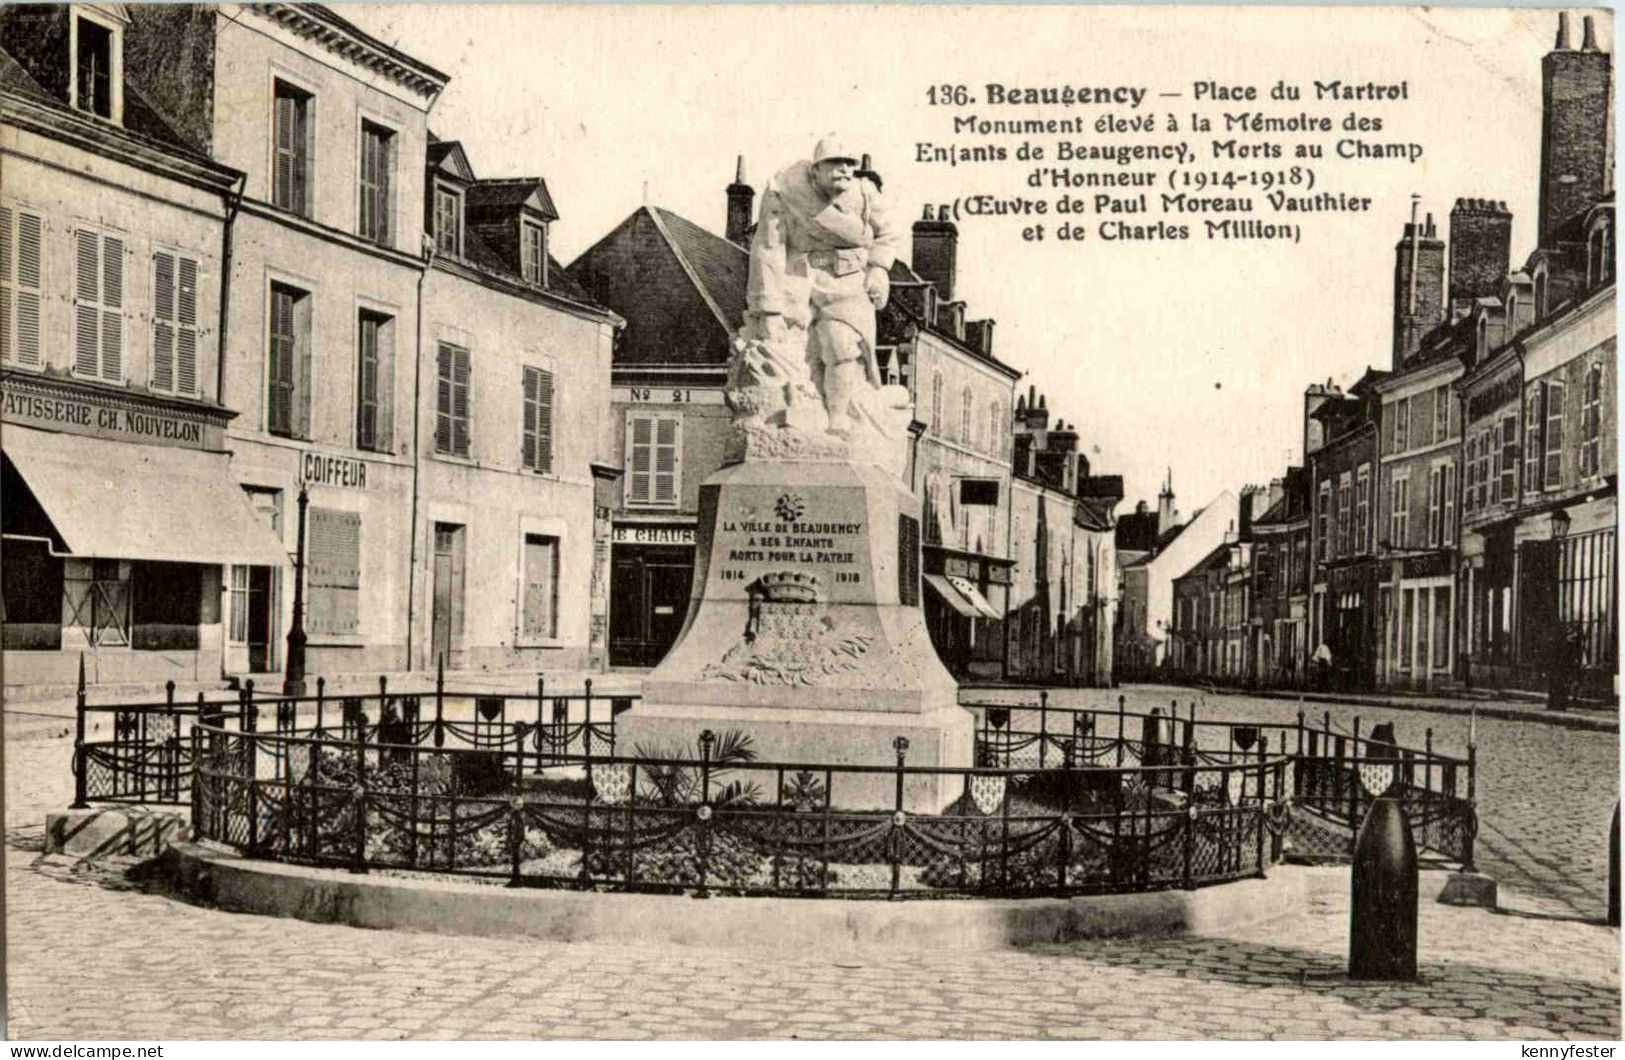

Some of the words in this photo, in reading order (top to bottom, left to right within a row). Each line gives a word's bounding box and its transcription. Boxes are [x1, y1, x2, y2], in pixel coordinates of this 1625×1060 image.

[672, 389, 690, 402] 21
[98, 409, 123, 431] CH.
[126, 413, 200, 443] NOUVELON
[304, 453, 367, 489] COIFFEUR
[723, 521, 737, 532] LA
[740, 522, 771, 533] VILLE
[775, 523, 789, 533] DE
[792, 523, 862, 535] BEAUGENCY
[760, 537, 781, 548] SES
[785, 536, 834, 548] ENFANTS
[729, 550, 765, 562] MORTS
[768, 551, 797, 562] POUR
[800, 552, 814, 563] LA
[816, 552, 855, 563] PATRIE
[721, 569, 745, 581] 1914
[836, 572, 860, 583] 1918
